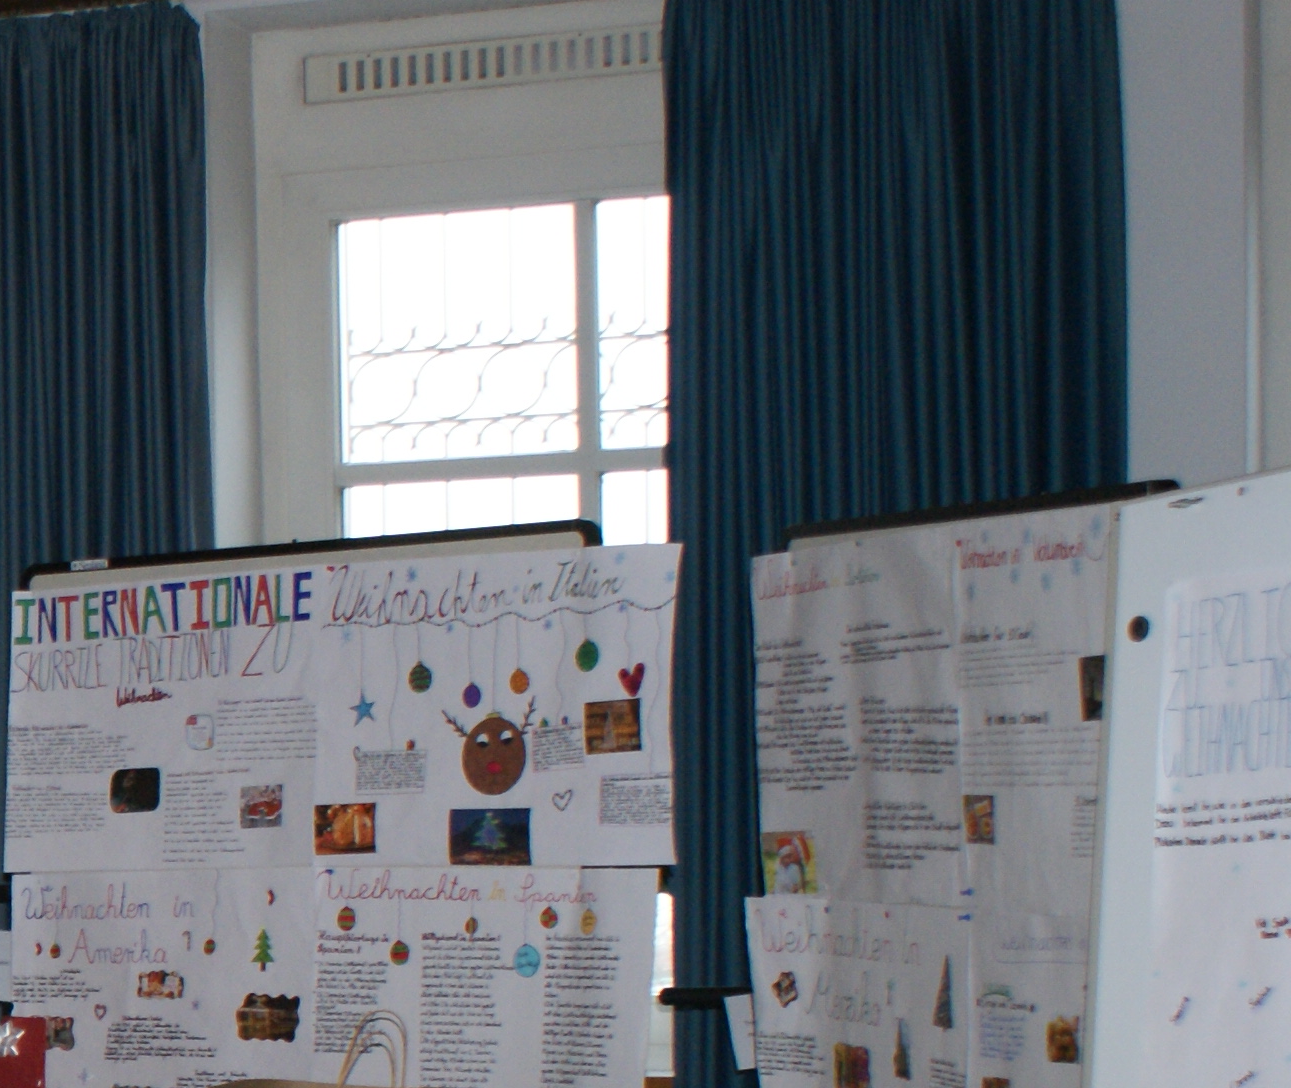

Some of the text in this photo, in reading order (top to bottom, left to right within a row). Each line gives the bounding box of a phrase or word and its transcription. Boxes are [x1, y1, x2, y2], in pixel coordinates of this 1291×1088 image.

[13, 572, 312, 645] INTERNATIONALE
[330, 564, 511, 624] Weihnachten
[21, 882, 195, 920] Weihnachten in
[317, 867, 481, 902] Weihnachten
[67, 928, 169, 965] Amerika
